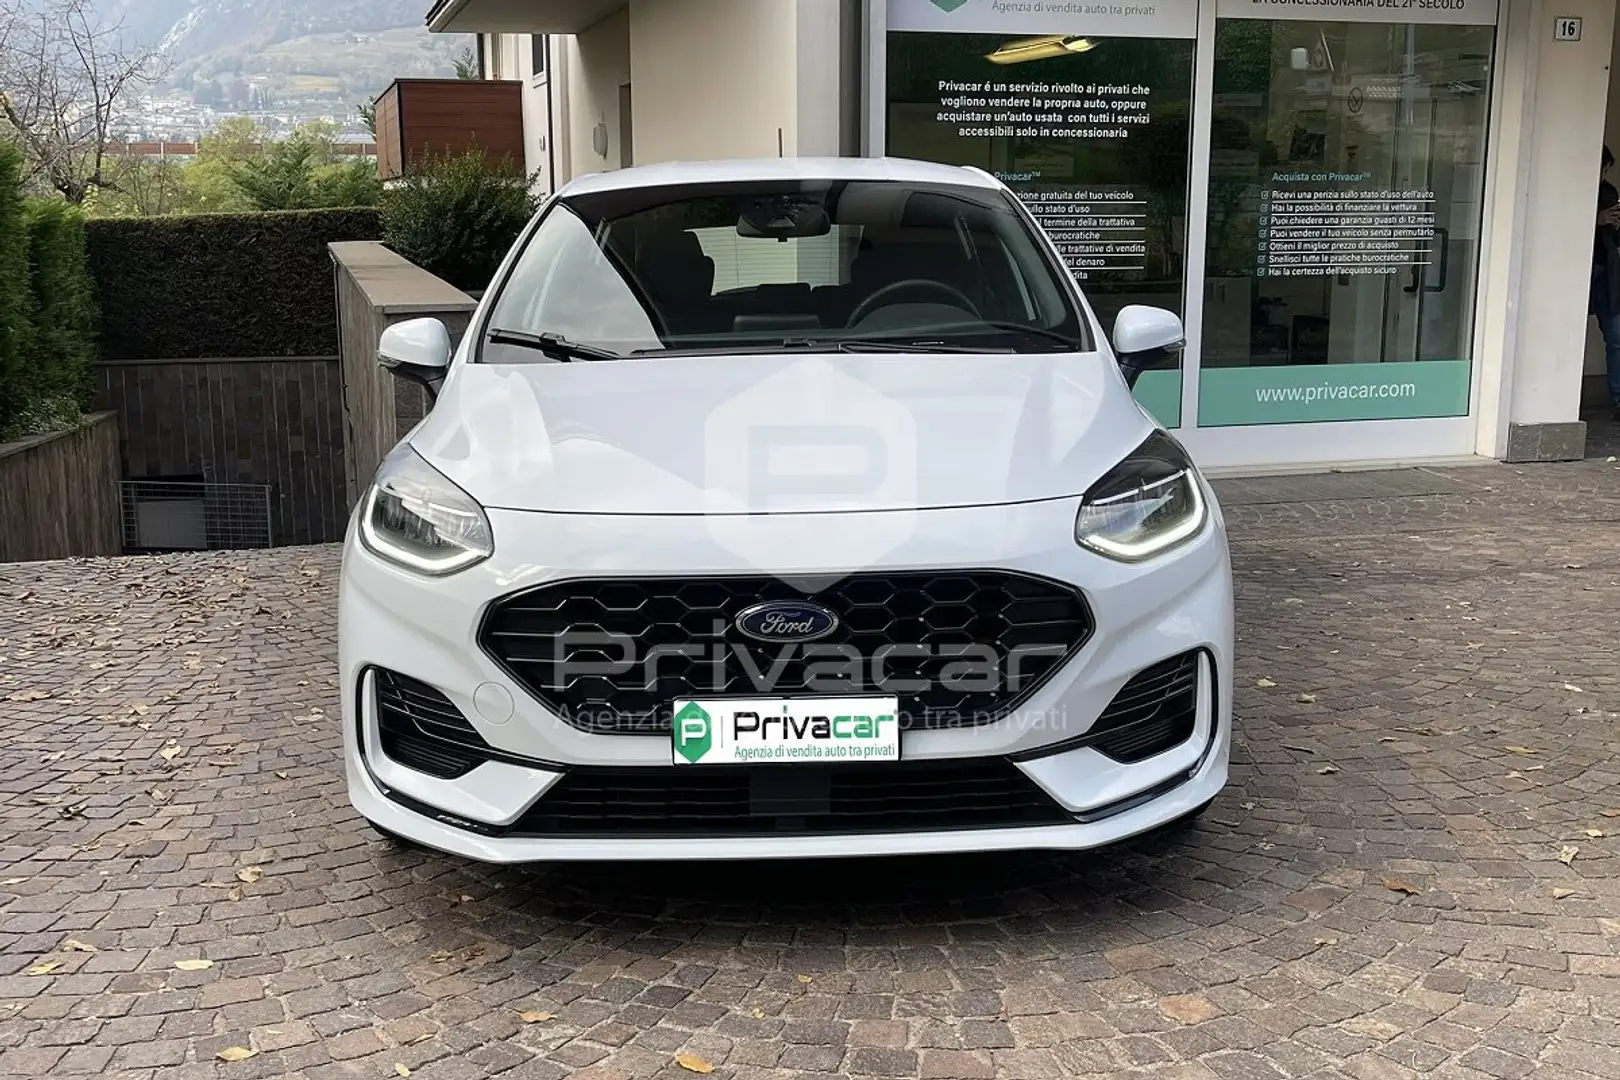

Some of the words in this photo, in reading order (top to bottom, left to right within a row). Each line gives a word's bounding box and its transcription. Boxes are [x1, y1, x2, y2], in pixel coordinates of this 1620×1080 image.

[992, 0, 1031, 13] Agenzia
[1034, 2, 1043, 12] di
[1046, 3, 1082, 13] vendita
[1084, 5, 1107, 14] auto
[1109, 5, 1123, 15] tra
[1124, 4, 1155, 17] privati
[1377, 0, 1399, 8] DEL
[1401, 0, 1417, 8] 21
[1418, 0, 1465, 10] SECOLO
[1561, 20, 1576, 37] 16
[938, 80, 982, 92] Privacar
[993, 83, 1007, 92] un
[1008, 82, 1049, 93] servizio
[1051, 83, 1084, 94] rivolto
[1086, 83, 1096, 94] ai
[1097, 84, 1130, 96] privati
[1131, 84, 1151, 95] che
[941, 96, 987, 109] vogliono
[988, 96, 1030, 107] vendere
[1032, 97, 1042, 108] la
[1044, 99, 1081, 111] propria
[1083, 99, 1109, 110] auto,
[1110, 101, 1148, 112] oppure
[936, 110, 992, 123] acquistare
[993, 111, 1033, 122] un'auto
[1034, 112, 1063, 123] usata
[1067, 114, 1087, 123] con
[1088, 112, 1110, 123] tutti
[1117, 113, 1151, 124] servizi
[958, 125, 1014, 137] accessibili
[1015, 126, 1038, 137] solo
[1039, 126, 1050, 137] in
[1051, 127, 1128, 138] concessionaria
[1272, 172, 1310, 182] Acquista
[1040, 190, 1073, 201] gratuita
[1074, 190, 1088, 200] del
[1089, 191, 1103, 200] tuo
[1104, 190, 1134, 200] veicolo
[1271, 190, 1296, 199] Ricevi
[1296, 191, 1312, 199] una
[1313, 190, 1339, 200] perizia
[1340, 189, 1359, 199] sullo
[1360, 190, 1379, 199] stato
[1027, 204, 1044, 213] ullo
[1044, 204, 1067, 213] stato
[1067, 203, 1091, 213] d'uso
[1271, 203, 1285, 213] Hai
[1286, 203, 1293, 212] la
[1294, 202, 1334, 214] possibilità
[1335, 203, 1344, 212] di
[1344, 202, 1381, 212] finanziare
[1382, 202, 1390, 212] la
[1390, 202, 1418, 212] vettura
[1043, 217, 1076, 227] termine
[1077, 217, 1098, 227] della
[1098, 217, 1136, 227] trattativa
[1270, 216, 1289, 225] Puoi
[1289, 215, 1323, 225] chiedere
[1324, 217, 1339, 225] una
[1340, 216, 1373, 226] garanzia
[1374, 215, 1397, 226] guasti
[1398, 215, 1406, 224] di
[1407, 215, 1415, 224] 12
[1416, 215, 1435, 224] mesi
[1049, 231, 1101, 241] burocratiche
[1270, 229, 1288, 238] Puoi
[1289, 228, 1320, 238] vendere
[1321, 228, 1327, 237] il
[1327, 228, 1341, 237] tuo
[1342, 228, 1369, 237] veicolo
[1370, 228, 1392, 237] senza
[1393, 227, 1435, 238] permutarlo
[1067, 244, 1105, 254] trattative
[1105, 244, 1114, 253] di
[1115, 243, 1146, 253] vendita
[1269, 241, 1296, 251] Ottieni
[1303, 241, 1330, 252] miglior
[1331, 241, 1357, 251] prezzo
[1358, 240, 1366, 250] di
[1366, 241, 1399, 250] acquisto
[1075, 257, 1106, 267] denaro
[1269, 254, 1301, 264] Snellisci
[1302, 254, 1320, 263] tutte
[1321, 253, 1329, 262] le
[1329, 253, 1361, 264] pratiche
[1362, 252, 1410, 262] burocratiche
[1268, 267, 1282, 276] Hai
[1282, 267, 1291, 276] la
[1291, 267, 1324, 276] certezza
[1373, 266, 1397, 274] sicuro
[1255, 381, 1416, 404] www.privacar.com
[760, 611, 814, 634] Ford
[681, 718, 707, 747] P
[733, 705, 895, 741] Privacar
[735, 745, 772, 760] Agenzia
[774, 744, 784, 757] di
[786, 744, 823, 757] vendita
[824, 745, 847, 757] auto
[848, 745, 862, 757] tra
[863, 743, 895, 759] privati
